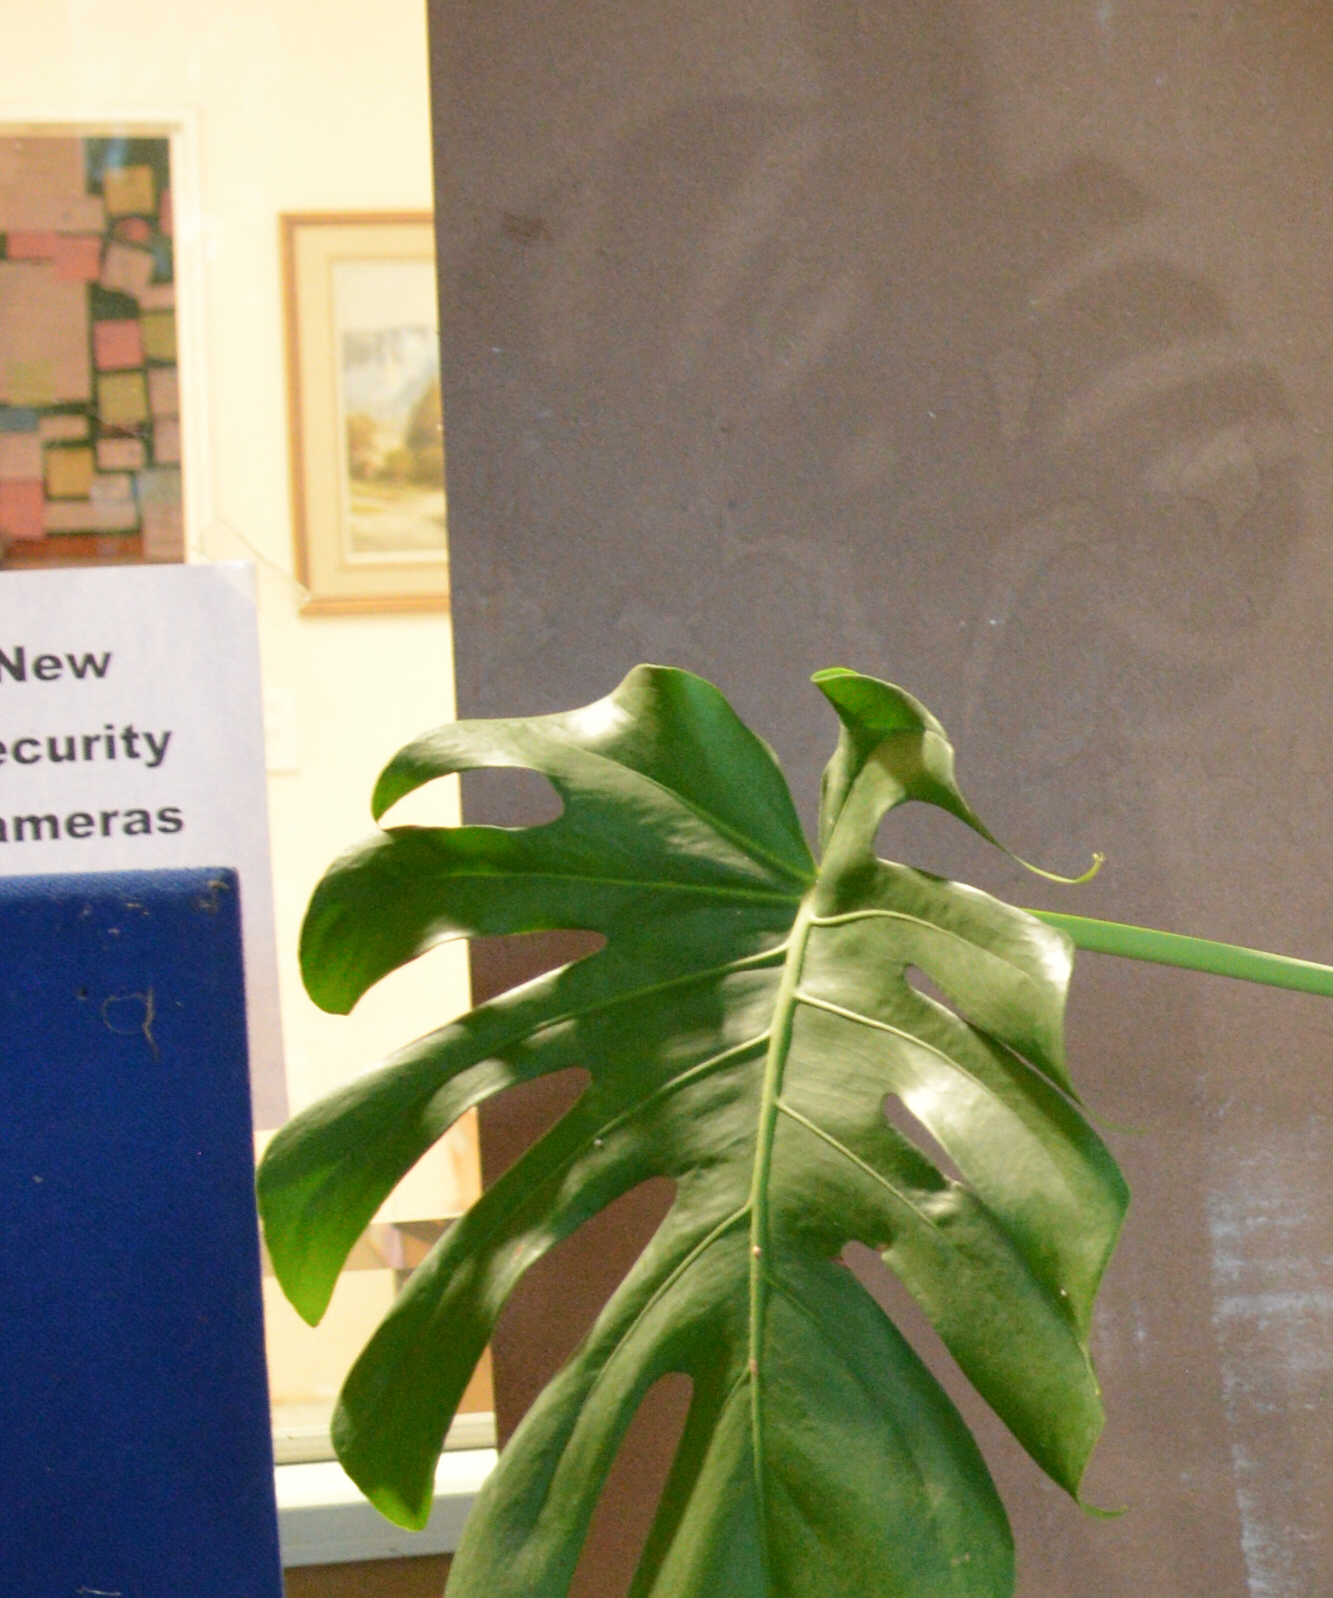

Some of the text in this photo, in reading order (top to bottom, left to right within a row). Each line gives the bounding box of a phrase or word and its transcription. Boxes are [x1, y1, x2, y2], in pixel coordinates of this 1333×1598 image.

[0, 645, 111, 682] New
[0, 723, 172, 768] curity
[0, 806, 184, 842] meras
